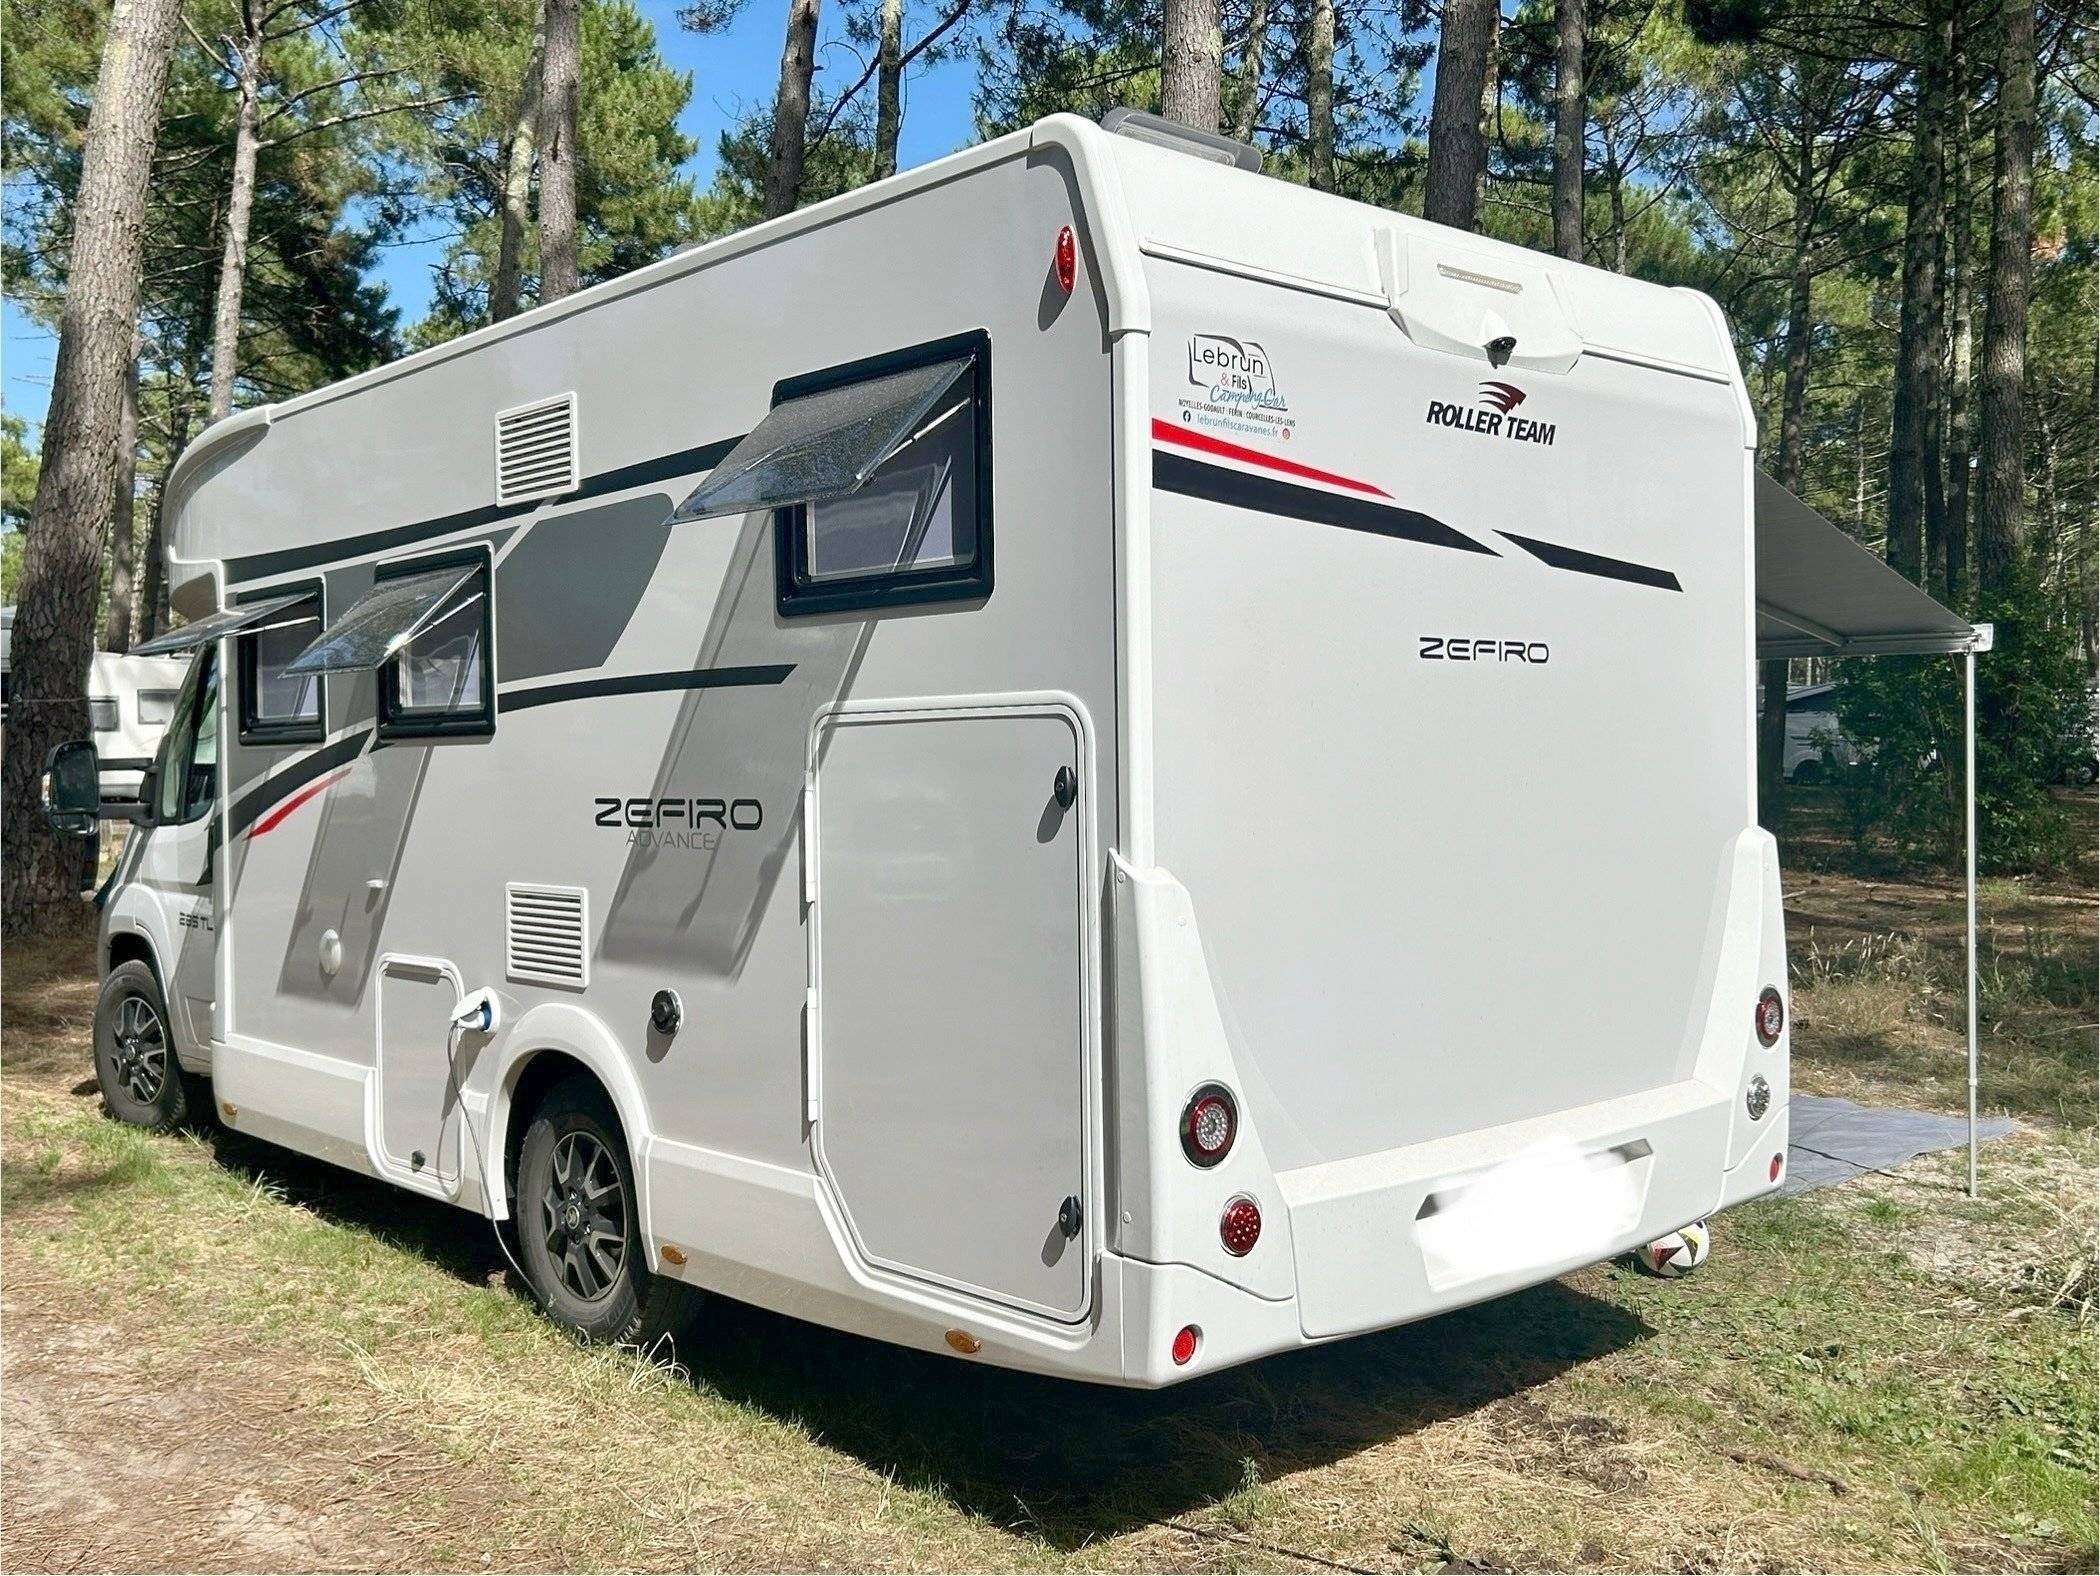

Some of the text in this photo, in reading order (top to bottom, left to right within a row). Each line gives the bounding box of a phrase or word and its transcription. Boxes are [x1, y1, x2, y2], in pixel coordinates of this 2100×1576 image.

[1193, 336, 1264, 376] Lebrun
[1220, 372, 1248, 390] & Fils
[1426, 400, 1557, 446] ROLLER TEAM
[1419, 636, 1549, 664] ZEFIRO
[594, 797, 764, 831] ZEFIRO
[624, 829, 716, 850] ADVANCE
